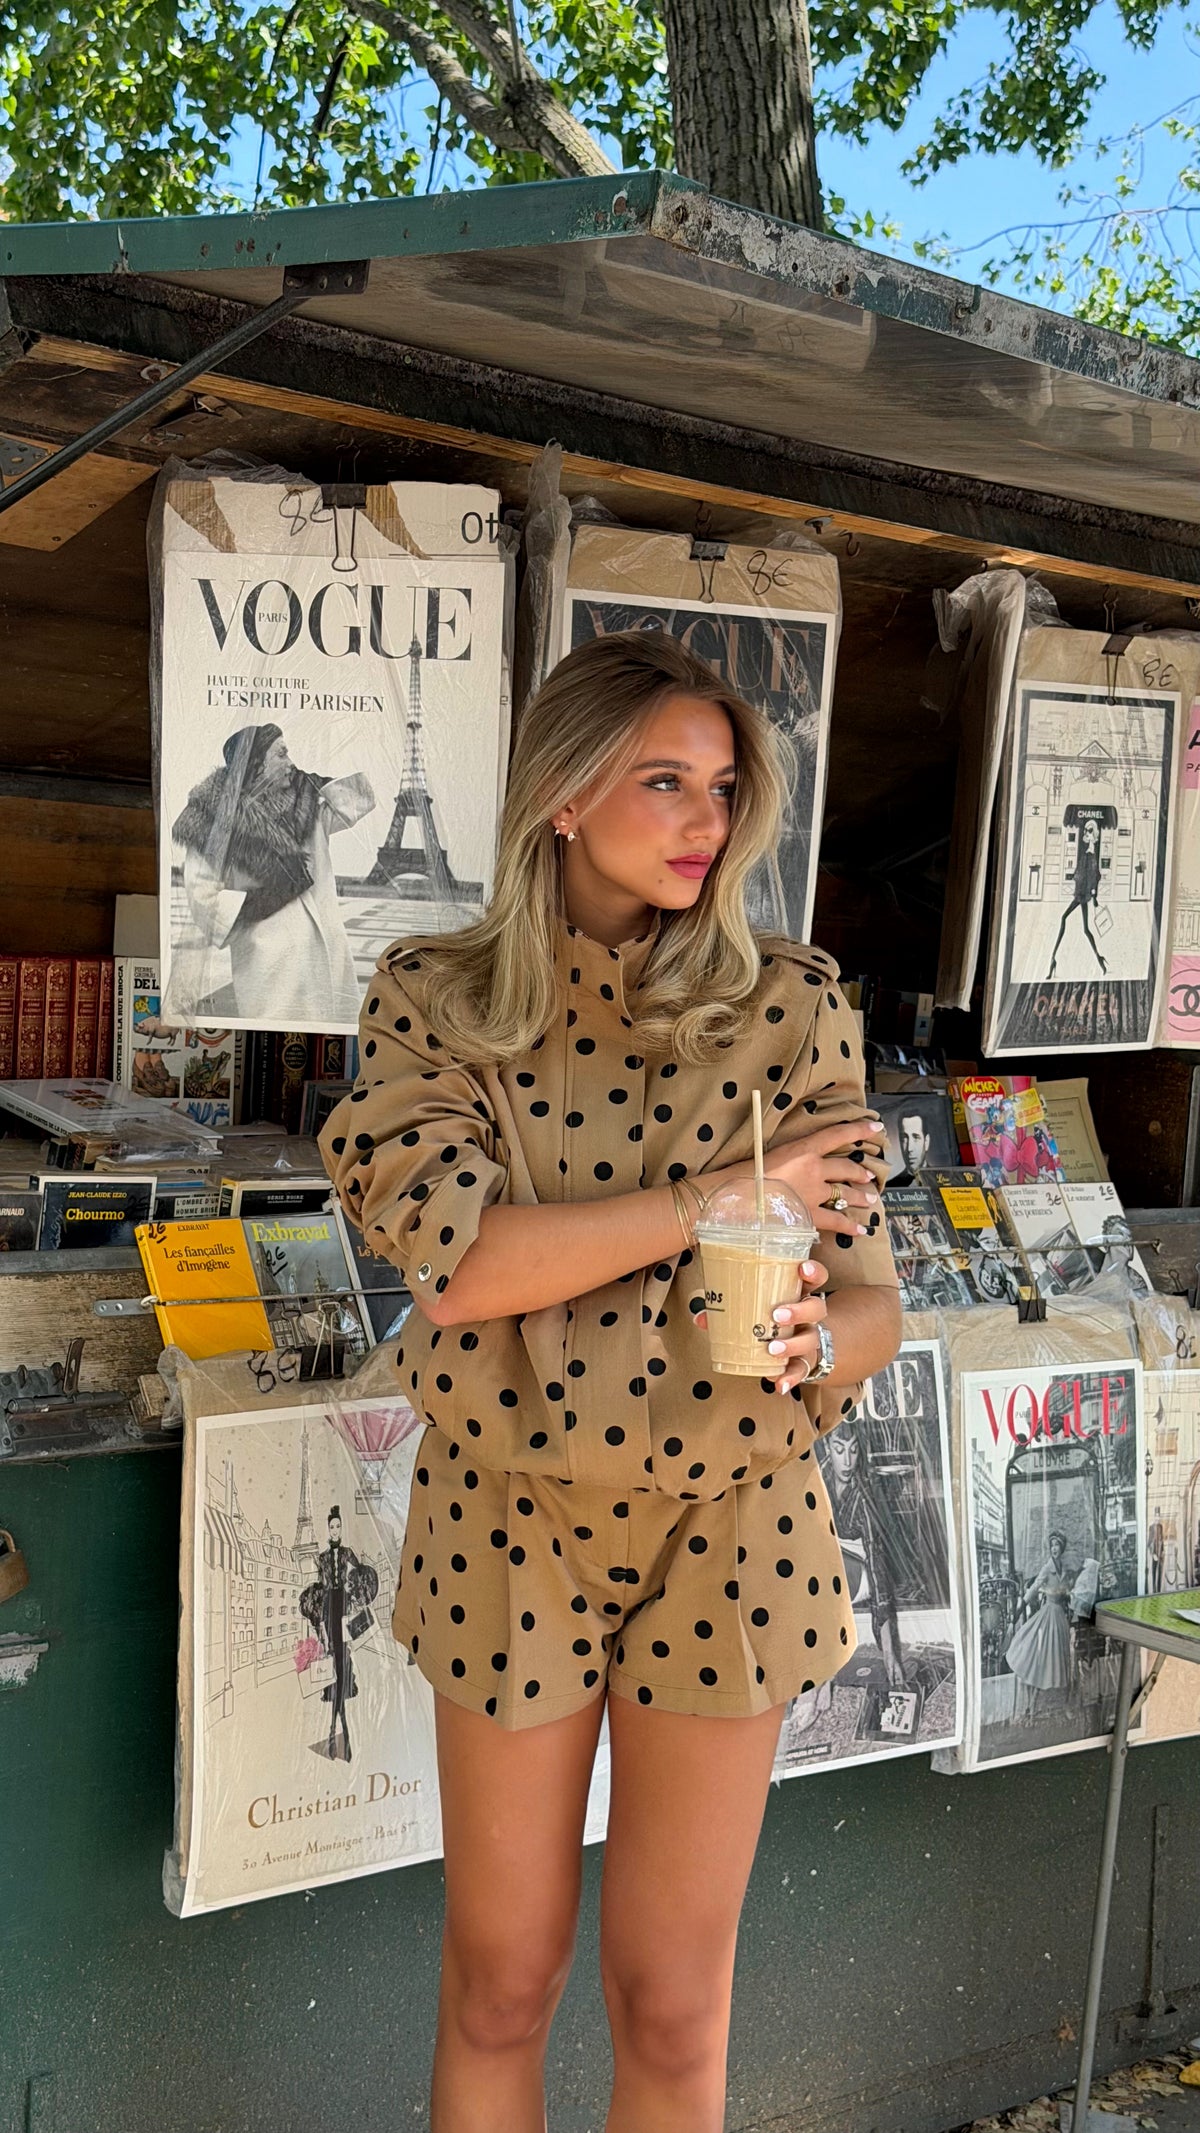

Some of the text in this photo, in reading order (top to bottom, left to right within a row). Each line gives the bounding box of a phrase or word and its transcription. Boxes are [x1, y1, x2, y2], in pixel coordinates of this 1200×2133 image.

[747, 550, 794, 595] 8€
[191, 577, 472, 661] VOGUE
[258, 612, 288, 624] PARIS
[207, 675, 310, 690] HAUTE COUTURE
[207, 689, 385, 713] L'ESPRIT PARISIEN
[1077, 810, 1105, 819] CHANEL
[134, 978, 150, 989] DE
[117, 1017, 123, 1030] LA
[117, 1031, 123, 1044] DE
[964, 1078, 1000, 1092] MICKEY
[1099, 1185, 1114, 1197] 2€
[1046, 1192, 1062, 1206] 3€
[66, 1208, 125, 1220] Chourmo
[176, 1207, 199, 1215] HOMME
[1025, 1208, 1053, 1218] pommes
[177, 1223, 210, 1232] EXBRAYAT
[251, 1221, 331, 1243] Exbrayat
[163, 1243, 236, 1259] Les fiançailles
[357, 1246, 371, 1257] Le
[176, 1259, 231, 1273] d'Imogène
[247, 1347, 297, 1394] 8€
[978, 1376, 1128, 1447] VOGUE
[247, 1772, 422, 1829] Christian Dior
[261, 1850, 302, 1867] Avenue
[305, 1836, 363, 1857] Montaigne
[374, 1825, 397, 1838] Paris
